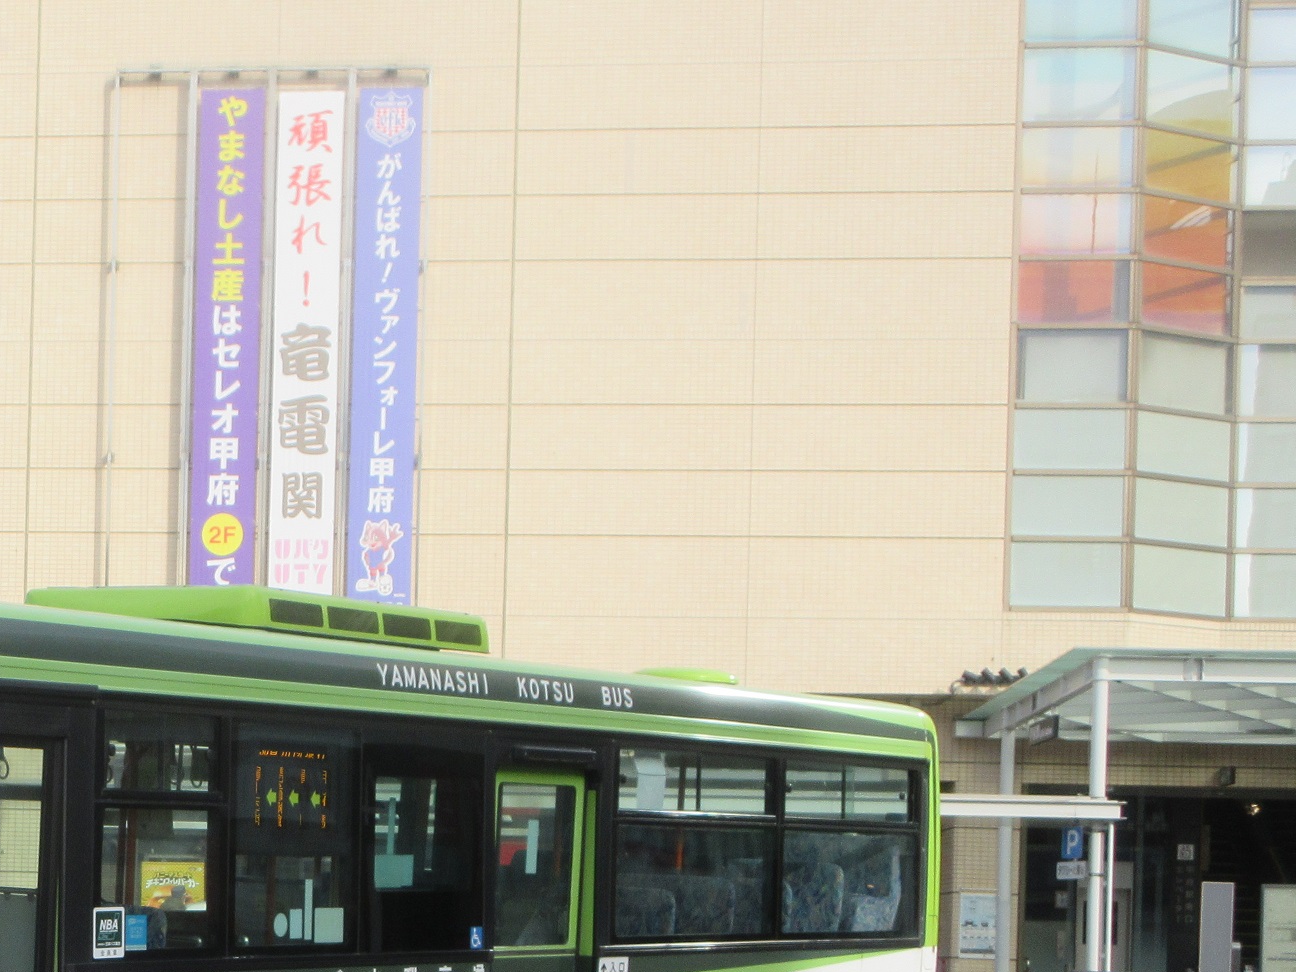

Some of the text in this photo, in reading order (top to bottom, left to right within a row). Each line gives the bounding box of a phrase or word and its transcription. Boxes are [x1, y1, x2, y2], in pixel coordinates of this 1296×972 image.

[376, 661, 634, 708] YAMANASHI KOTSU BUS
[1066, 829, 1079, 855] P
[99, 918, 119, 931] NBA
[609, 961, 625, 972] 入口
